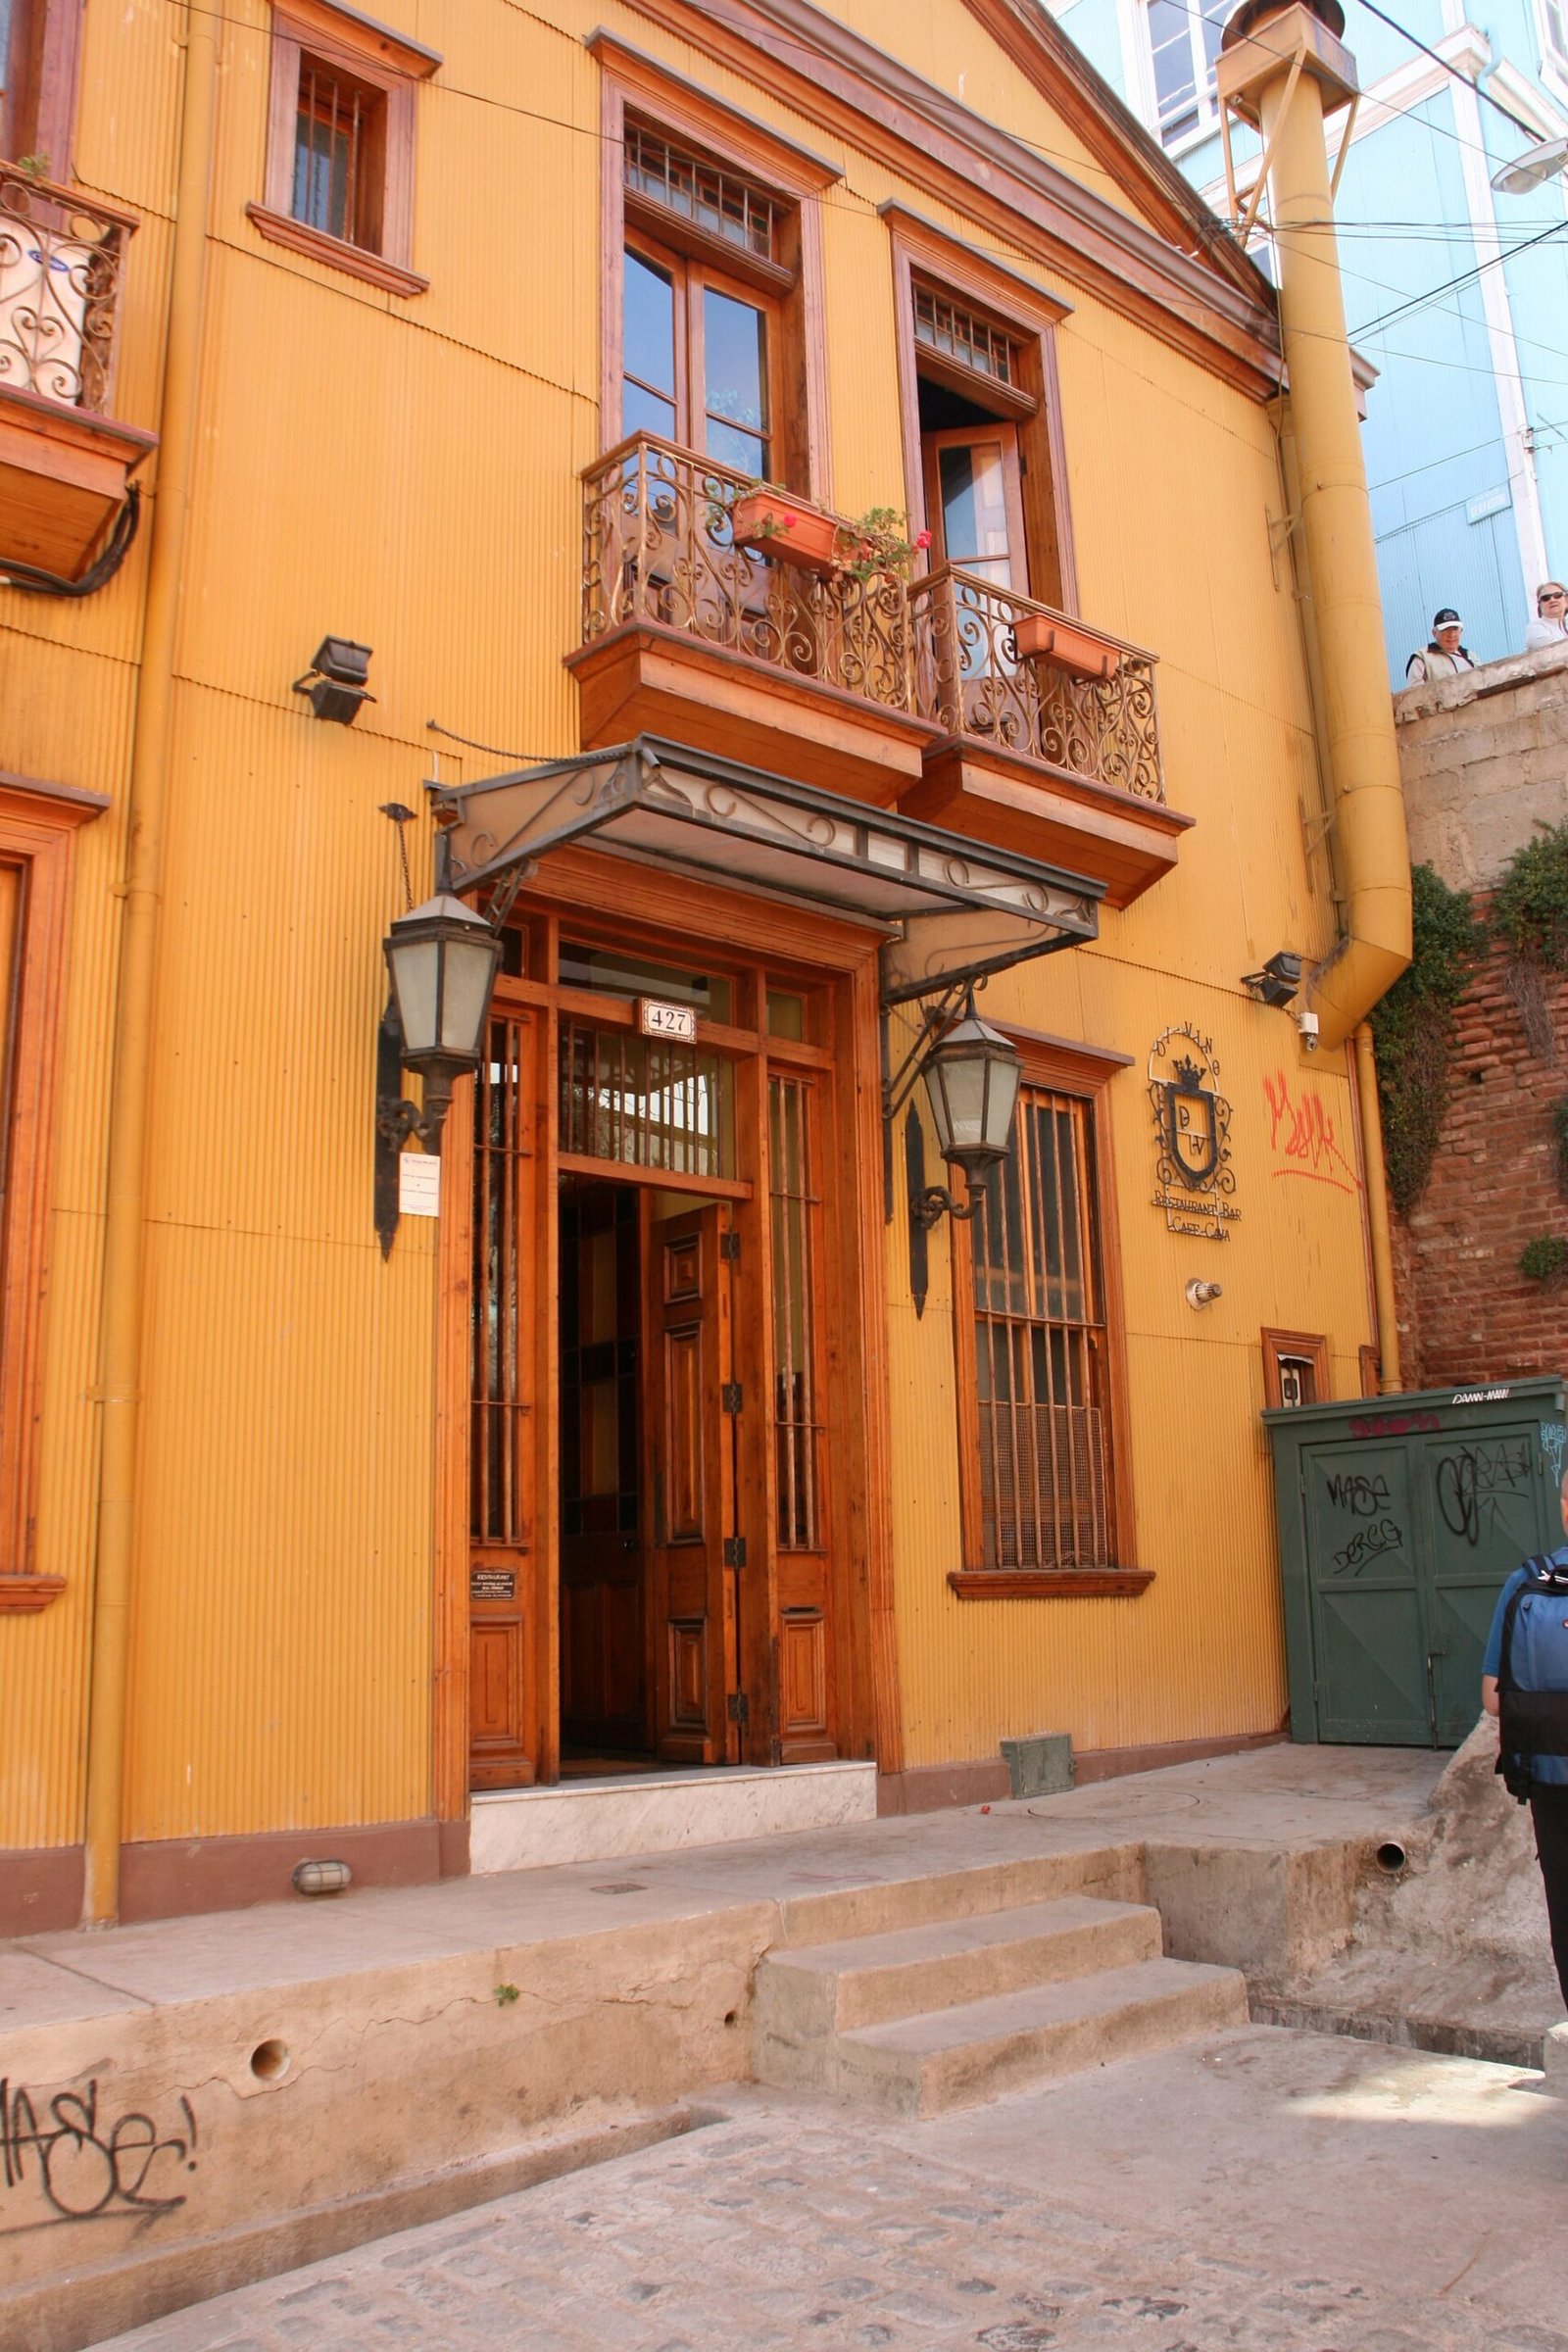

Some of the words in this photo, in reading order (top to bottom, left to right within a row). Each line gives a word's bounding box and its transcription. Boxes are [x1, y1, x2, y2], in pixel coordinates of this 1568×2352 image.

[651, 1009, 686, 1031] 427
[1153, 1189, 1217, 1215] RESTAURANT
[1221, 1201, 1242, 1222] BAR
